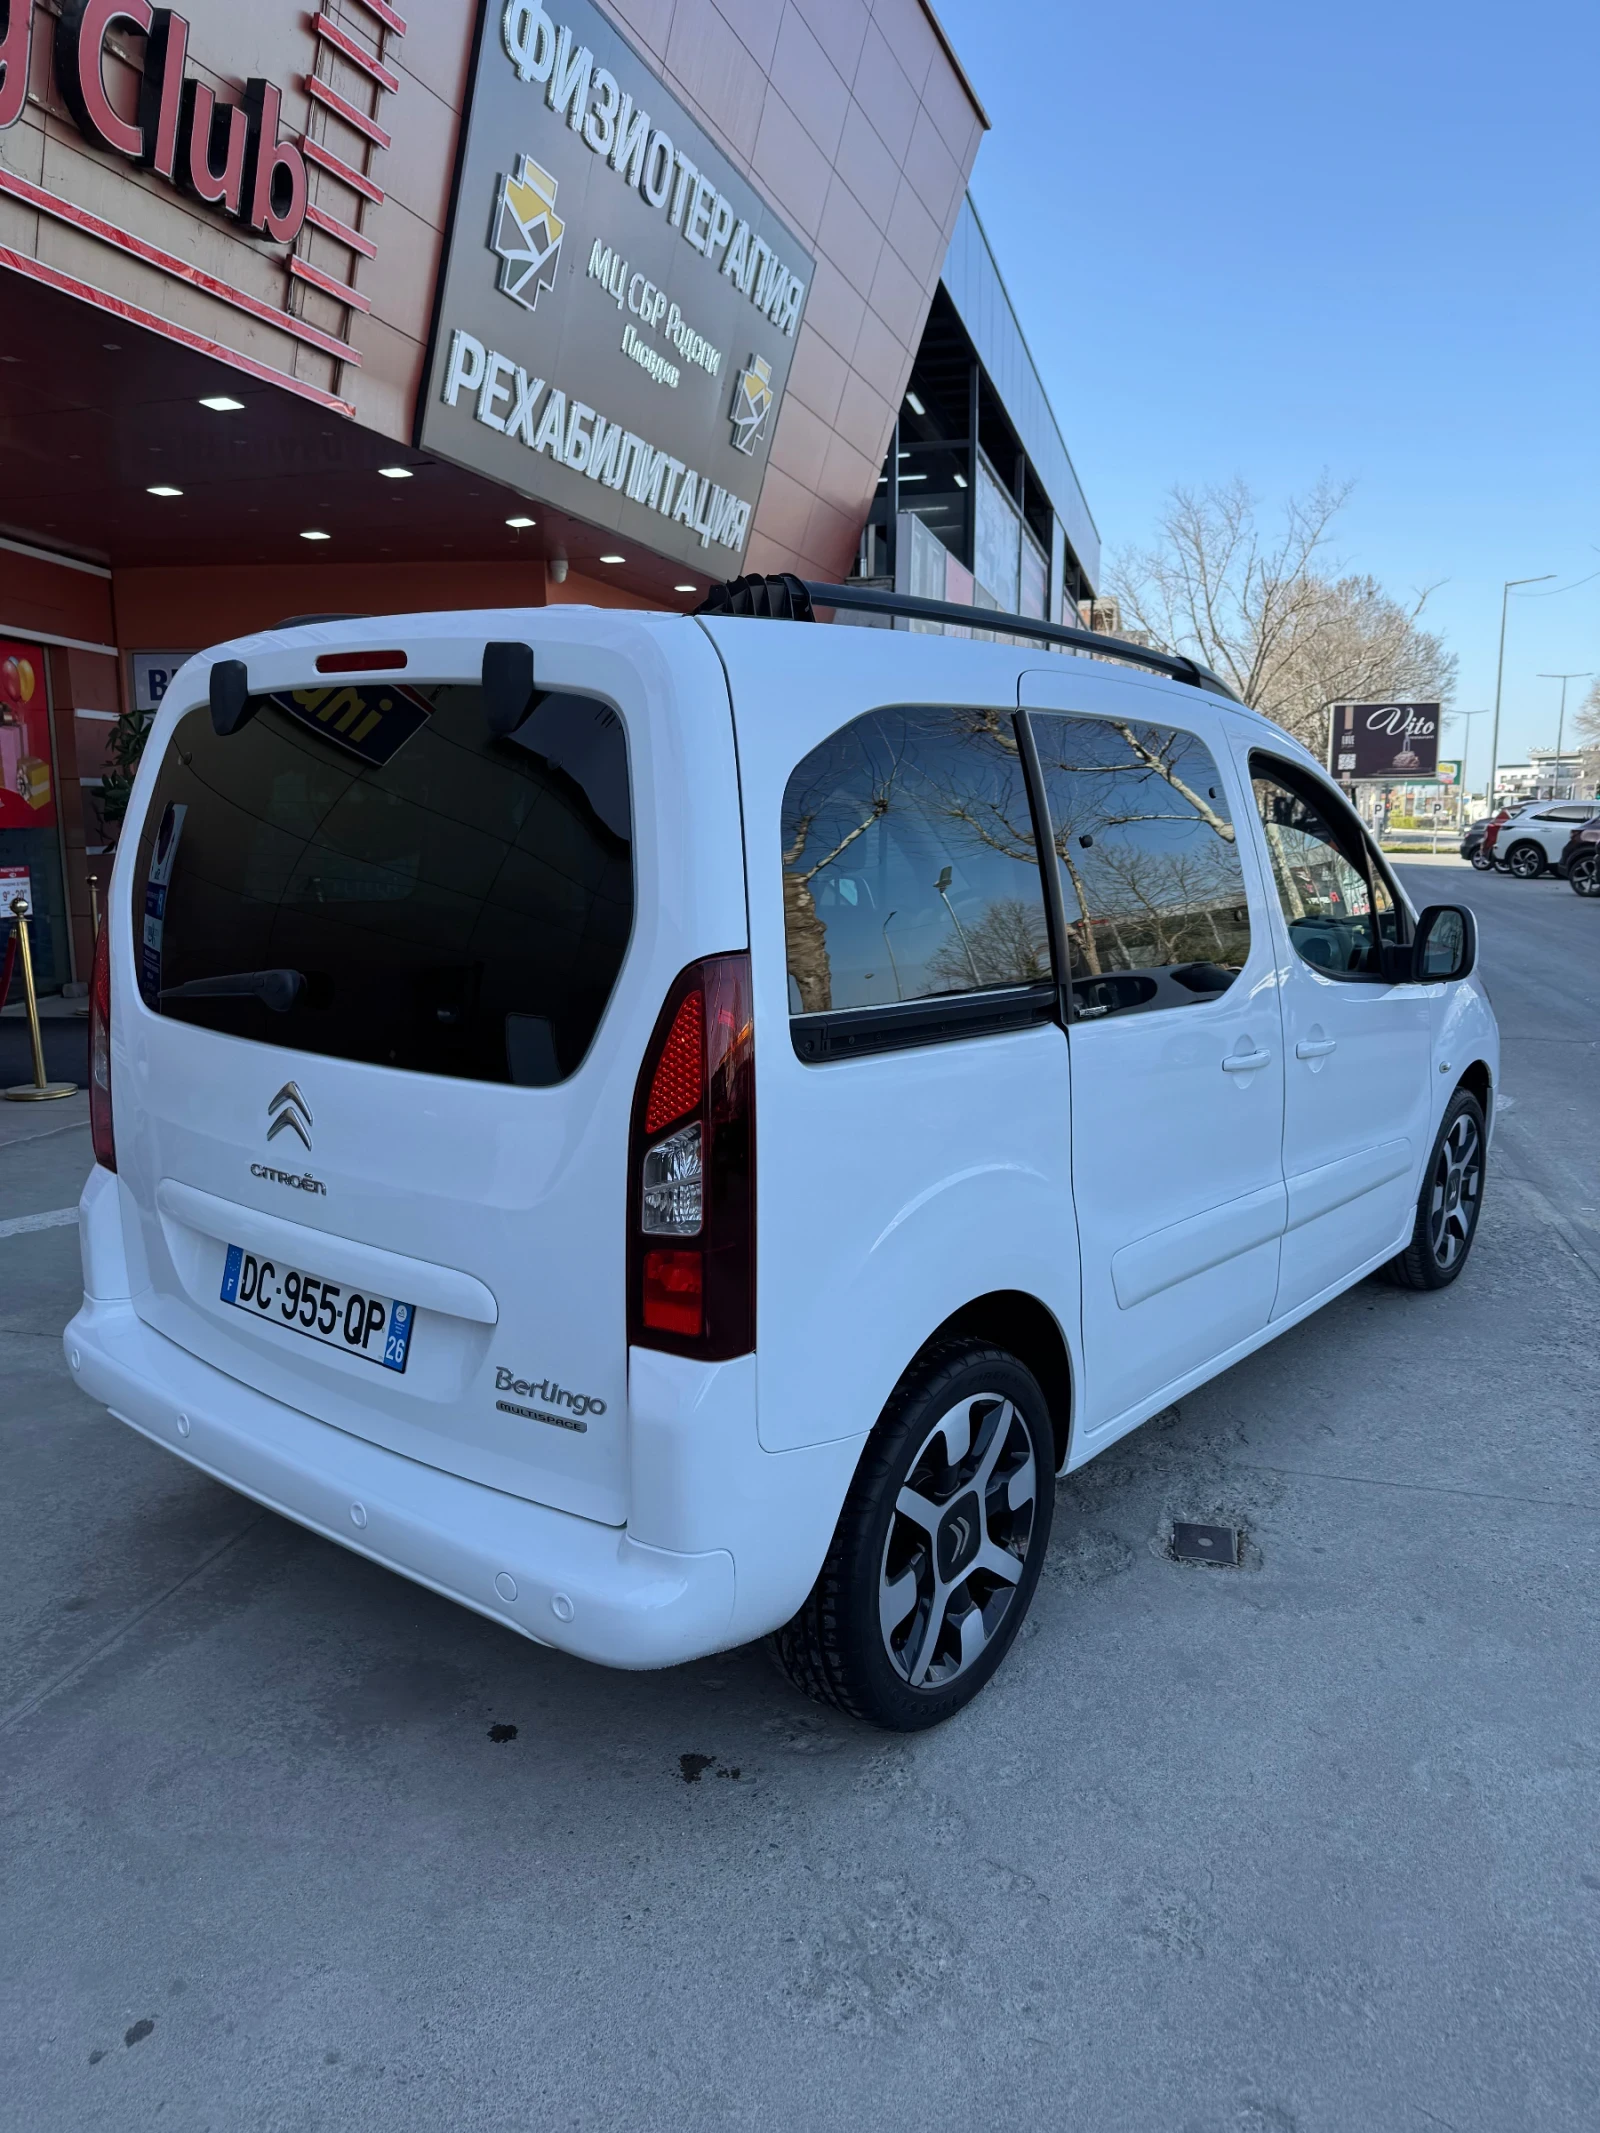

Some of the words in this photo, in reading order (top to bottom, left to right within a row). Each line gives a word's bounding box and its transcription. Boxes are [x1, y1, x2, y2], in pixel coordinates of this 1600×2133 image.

[78, 0, 309, 244] Club
[500, 0, 805, 338] ФИЗИОТЕРАПИЯ
[587, 238, 629, 310] МЦ
[627, 272, 667, 328] СБР
[665, 303, 722, 377] Родопи
[621, 323, 681, 388] Пловдив
[443, 329, 752, 552] РЕХАБИЛИТАЦИЯ
[1366, 706, 1435, 736] Vito
[1374, 804, 1383, 815] P
[1433, 803, 1442, 814] P
[227, 1278, 234, 1291] F
[385, 1335, 405, 1363] 26
[495, 1365, 608, 1416] Berlingo
[499, 1402, 582, 1431] MULTISPACE
